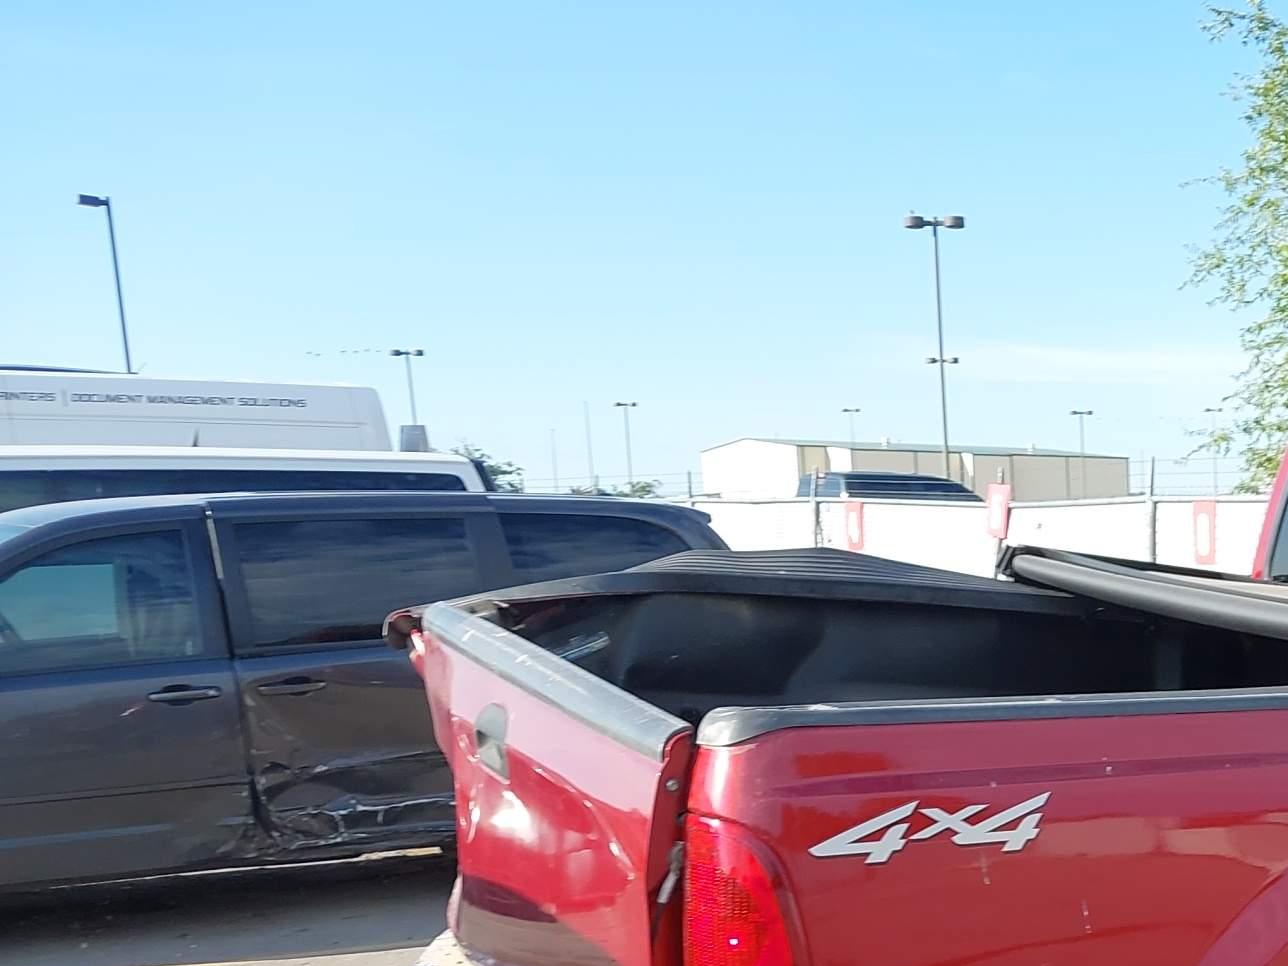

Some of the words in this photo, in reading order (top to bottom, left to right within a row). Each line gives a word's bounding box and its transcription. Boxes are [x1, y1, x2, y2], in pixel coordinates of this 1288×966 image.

[70, 392, 145, 404] DOCUMENT
[146, 394, 235, 406] MANAGEMENT
[237, 396, 308, 408] SOLUTIONS
